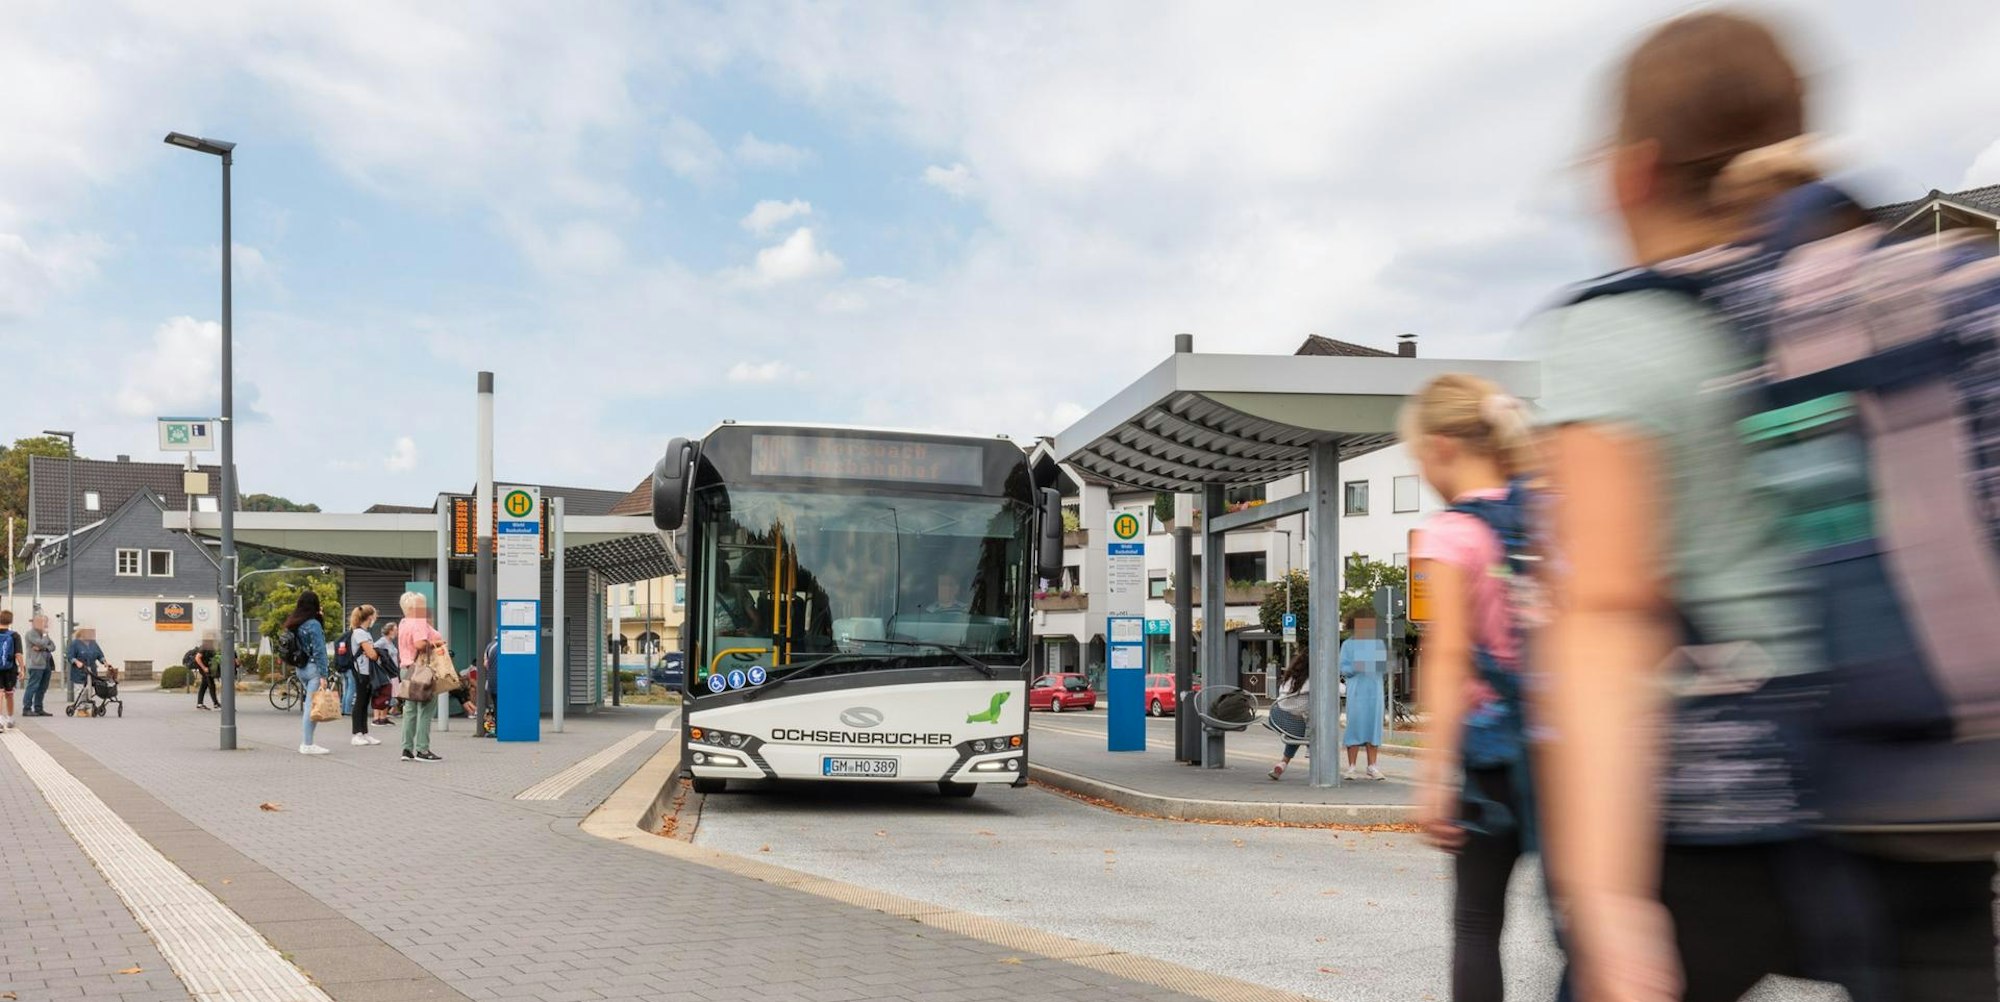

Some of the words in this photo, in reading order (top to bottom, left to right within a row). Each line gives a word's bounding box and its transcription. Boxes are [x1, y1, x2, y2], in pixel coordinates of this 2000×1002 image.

[512, 496, 525, 512] H
[1121, 519, 1132, 534] H
[1285, 615, 1293, 626] P
[771, 728, 952, 745] OCHSENBRÜCHER
[831, 760, 848, 772] GM
[854, 761, 871, 772] HO
[873, 761, 895, 773] 389
